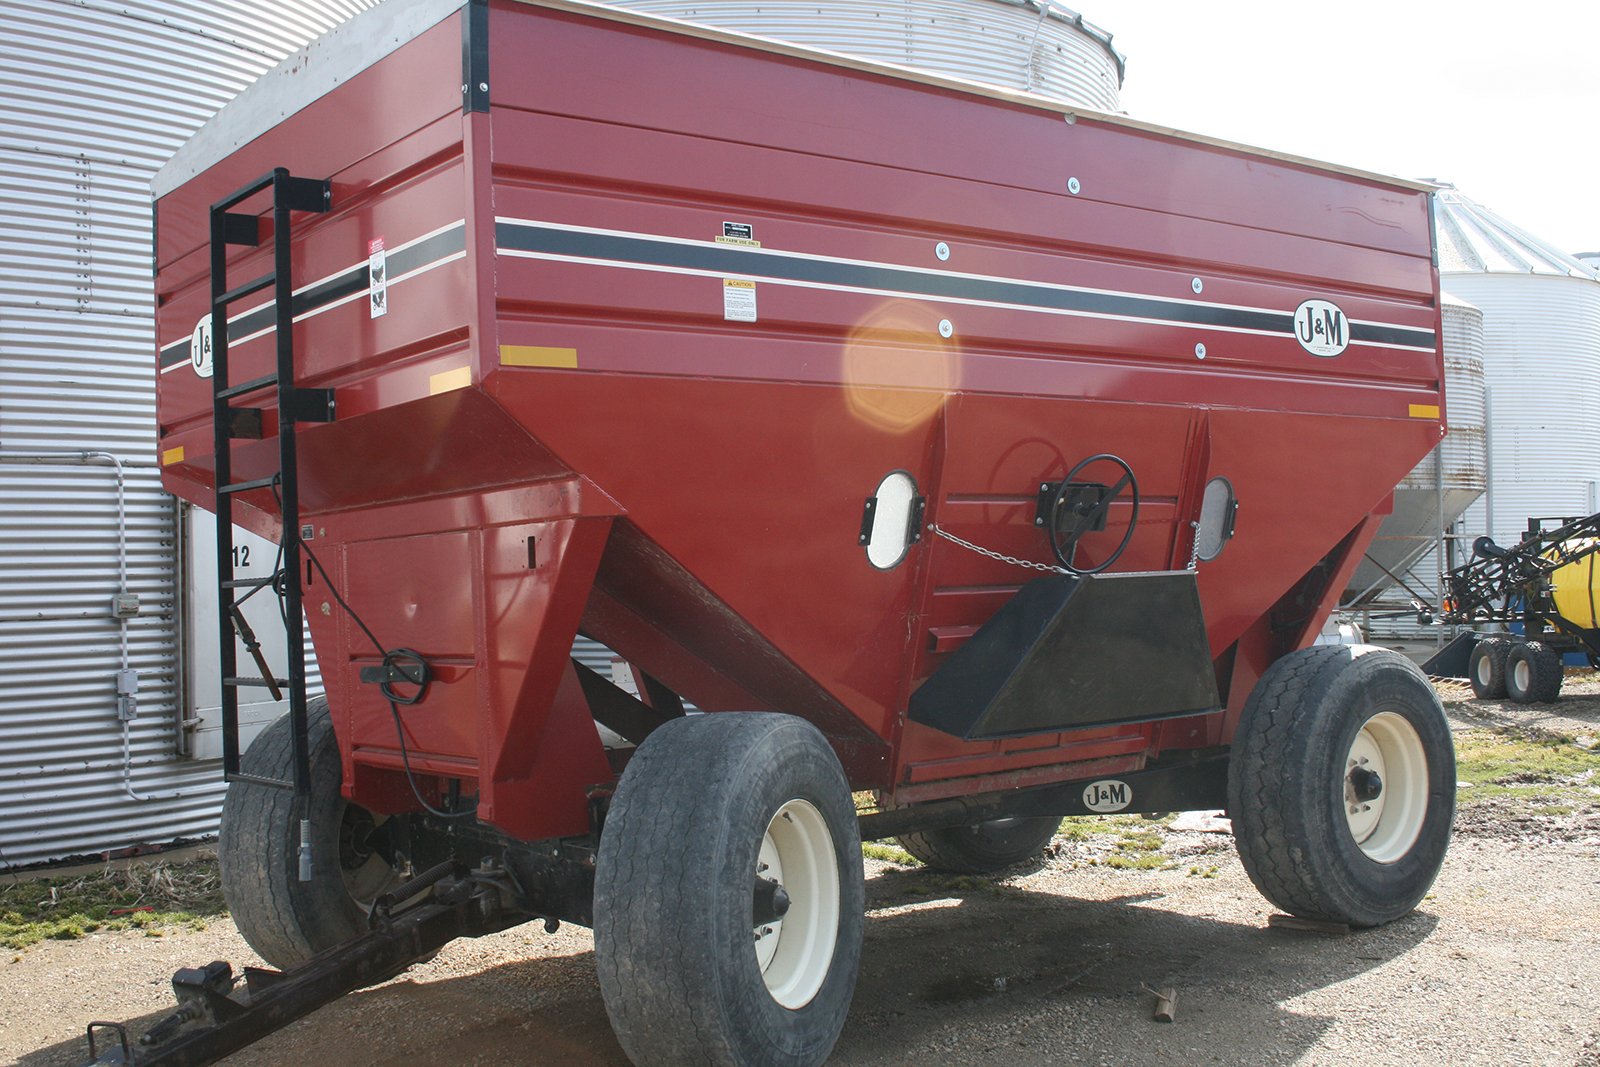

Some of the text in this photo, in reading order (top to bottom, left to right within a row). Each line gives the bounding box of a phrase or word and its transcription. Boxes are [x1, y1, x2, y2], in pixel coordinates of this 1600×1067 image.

[1298, 306, 1343, 347] J&M
[194, 325, 212, 368] J&
[232, 545, 250, 567] 12
[1086, 783, 1127, 806] J&M
